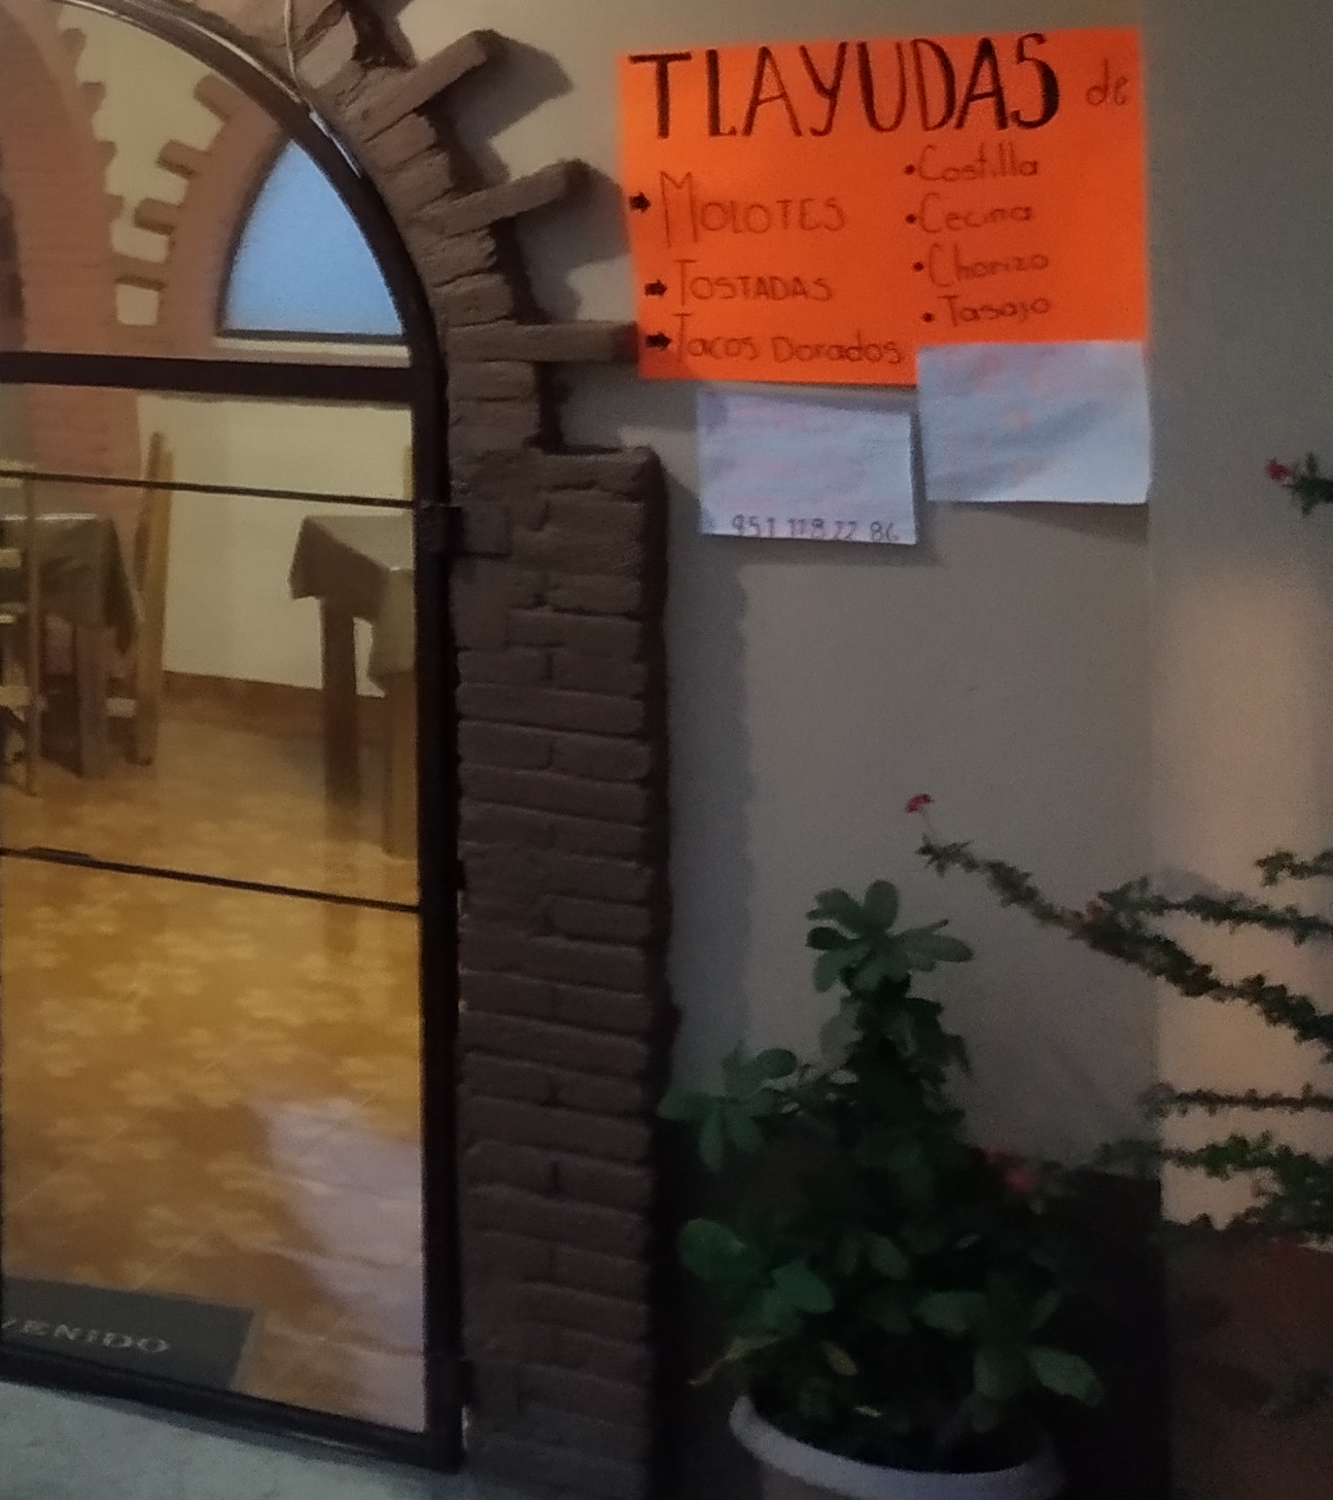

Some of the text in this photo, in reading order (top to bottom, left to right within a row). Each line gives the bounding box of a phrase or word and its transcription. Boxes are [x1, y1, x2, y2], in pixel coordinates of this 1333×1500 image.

[628, 32, 1130, 138] TLAYUDAS de
[918, 142, 1039, 183] Costilla
[919, 192, 1033, 234] Cecina
[929, 242, 1049, 288] Chorizo
[937, 296, 1051, 327] Tasajo
[672, 312, 903, 364] Tacos Dorados
[732, 513, 777, 538] 951
[869, 520, 900, 542] 86
